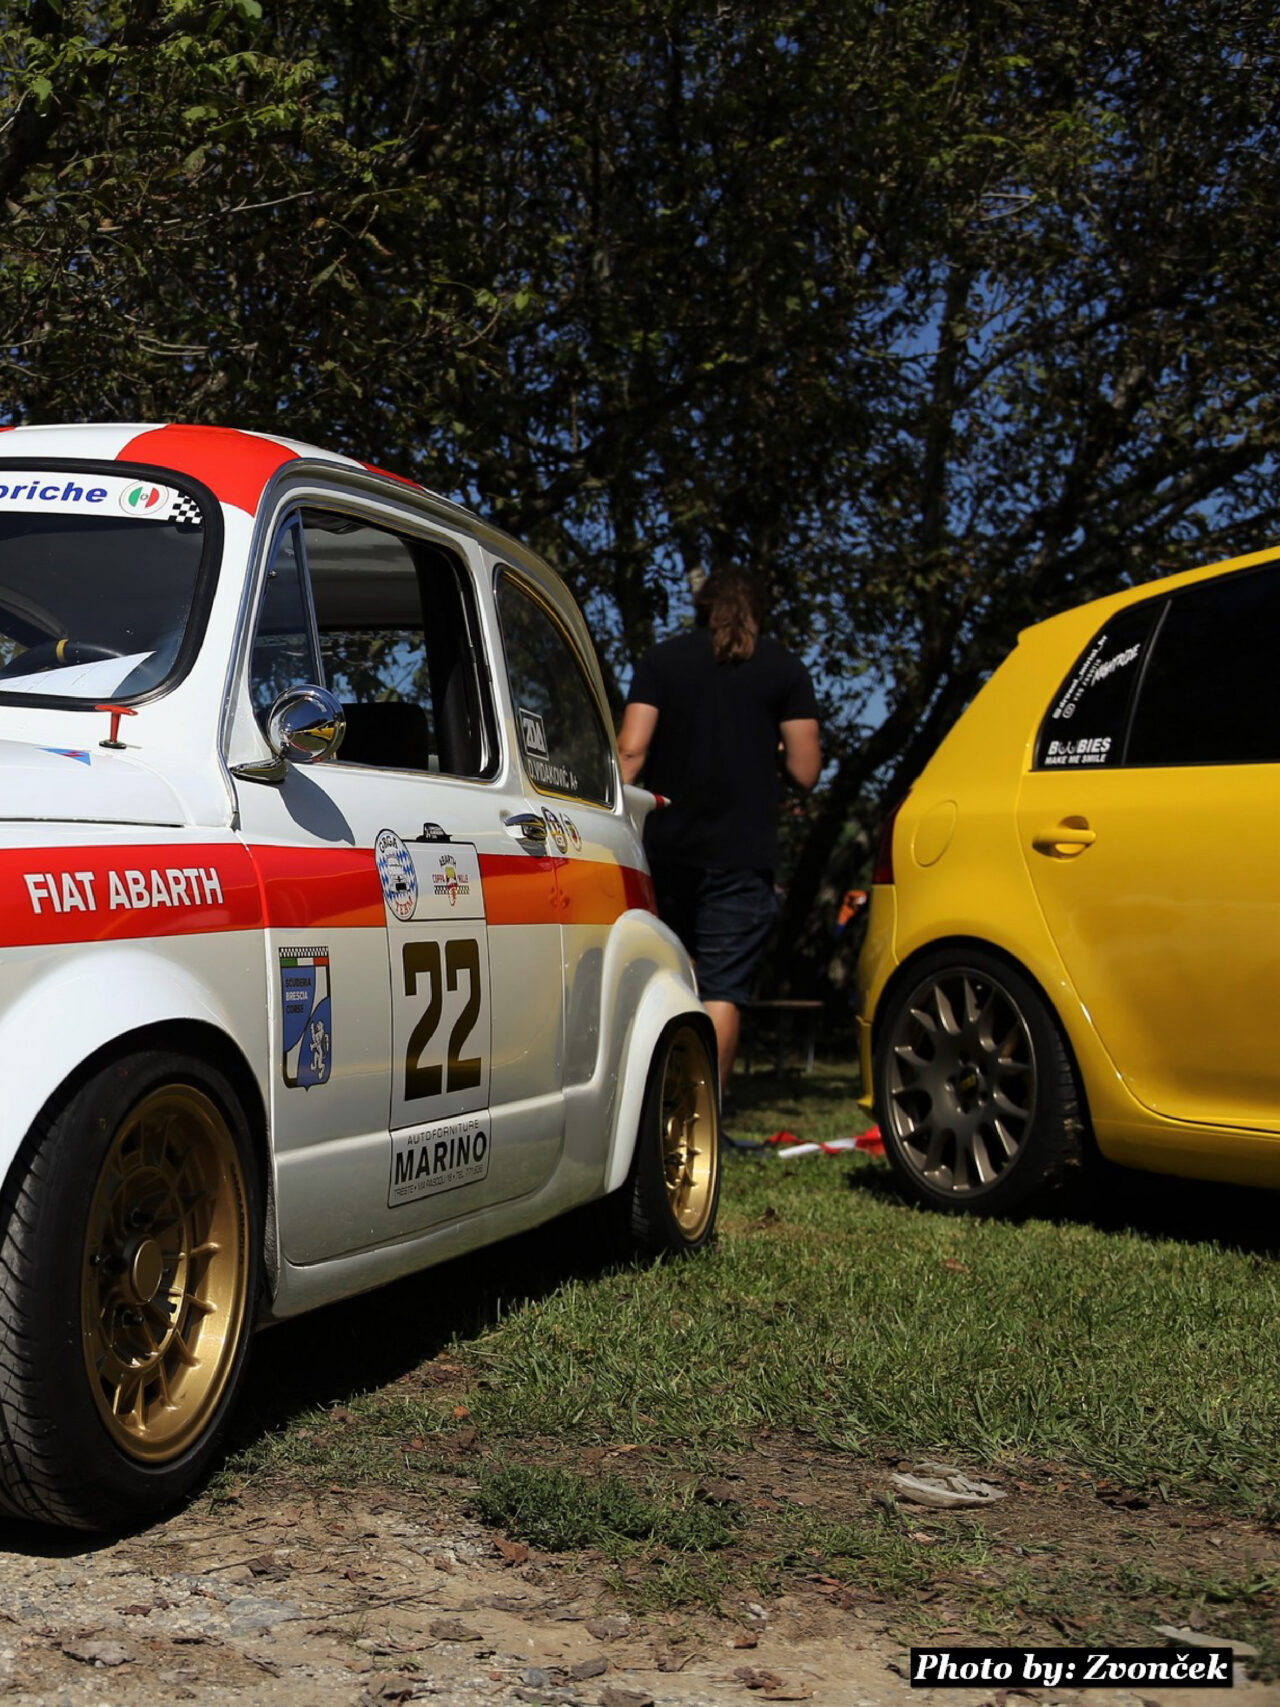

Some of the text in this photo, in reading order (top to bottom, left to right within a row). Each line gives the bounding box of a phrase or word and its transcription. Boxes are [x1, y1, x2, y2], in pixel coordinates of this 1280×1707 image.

[1044, 753, 1107, 765] MAKE ME SMILE
[23, 867, 224, 914] FIAT ABARTH
[402, 938, 481, 1101] 22
[407, 1120, 479, 1145] AUTOFORNITURE
[395, 1132, 487, 1185] MARINO
